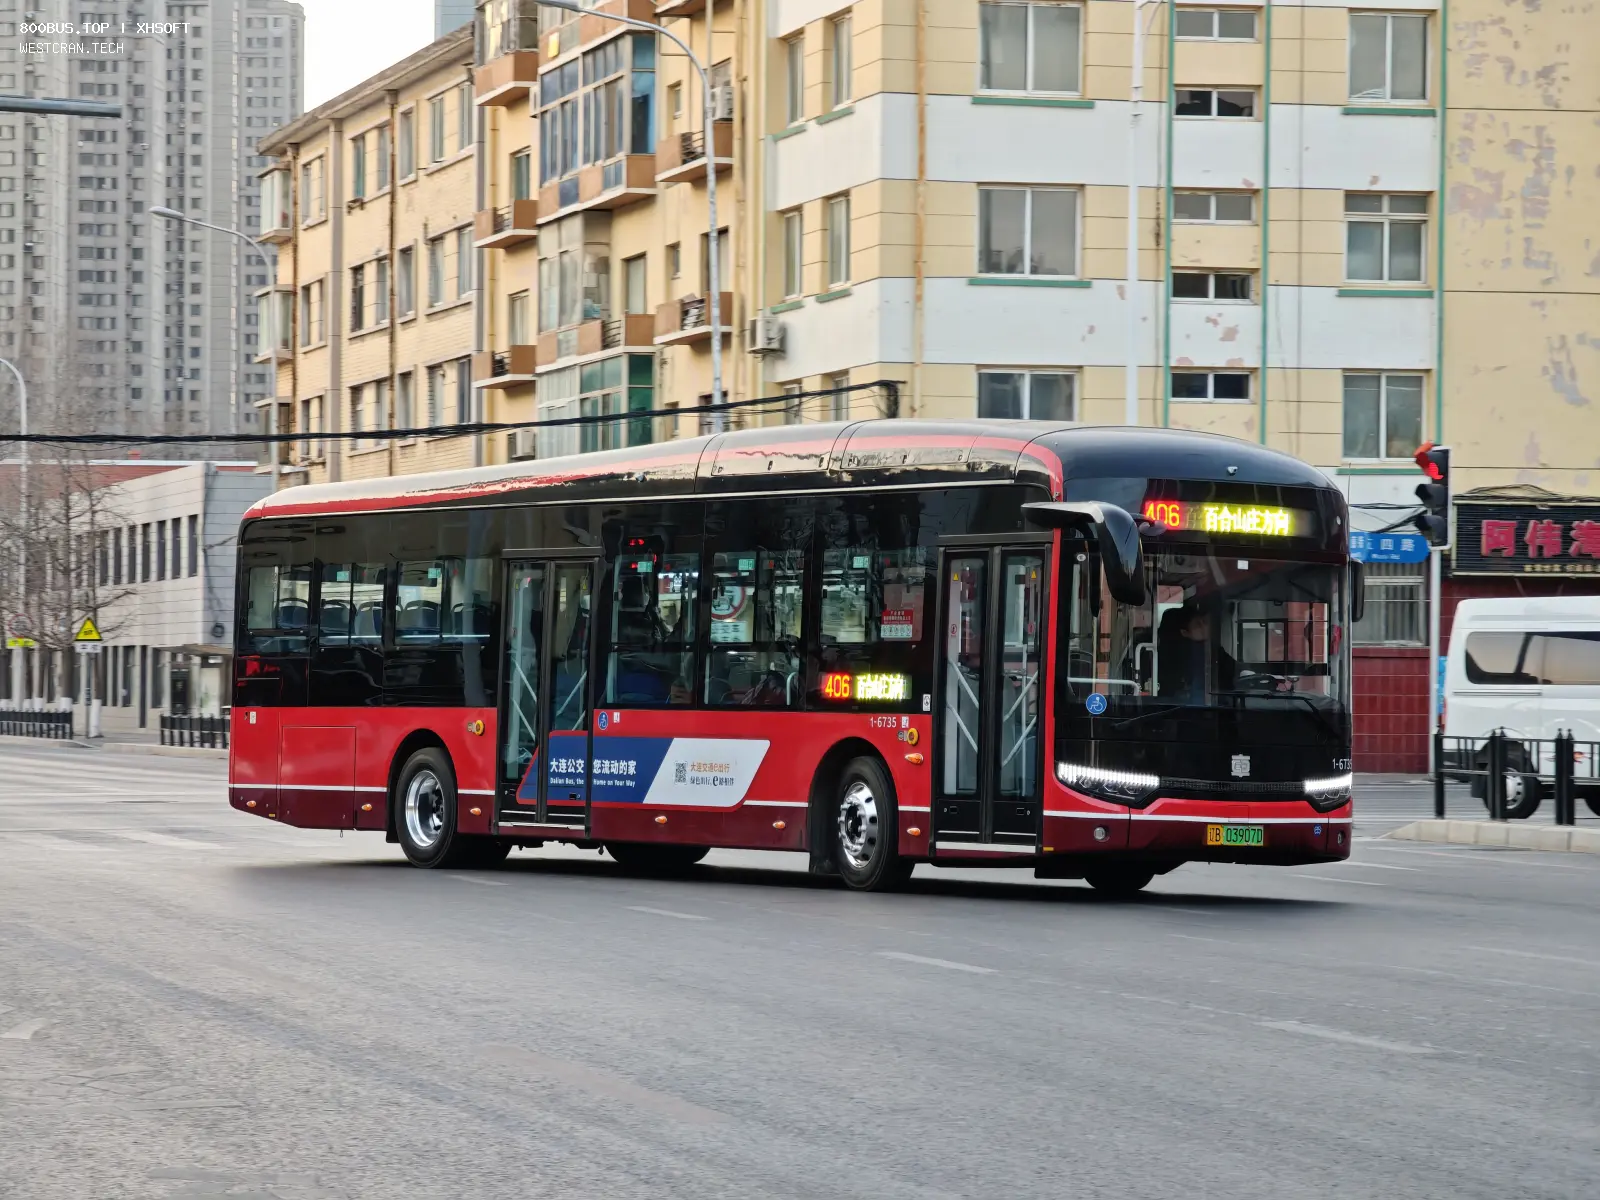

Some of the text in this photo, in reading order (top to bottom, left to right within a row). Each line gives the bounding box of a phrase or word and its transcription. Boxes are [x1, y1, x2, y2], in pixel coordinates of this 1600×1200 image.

[1145, 502, 1290, 536] 406 百合山庄方向
[825, 674, 850, 698] 406
[869, 715, 897, 728] 1-6735
[550, 757, 637, 775] 大连公交 您流动的家
[550, 777, 564, 785] Dalian
[626, 780, 636, 788] Way
